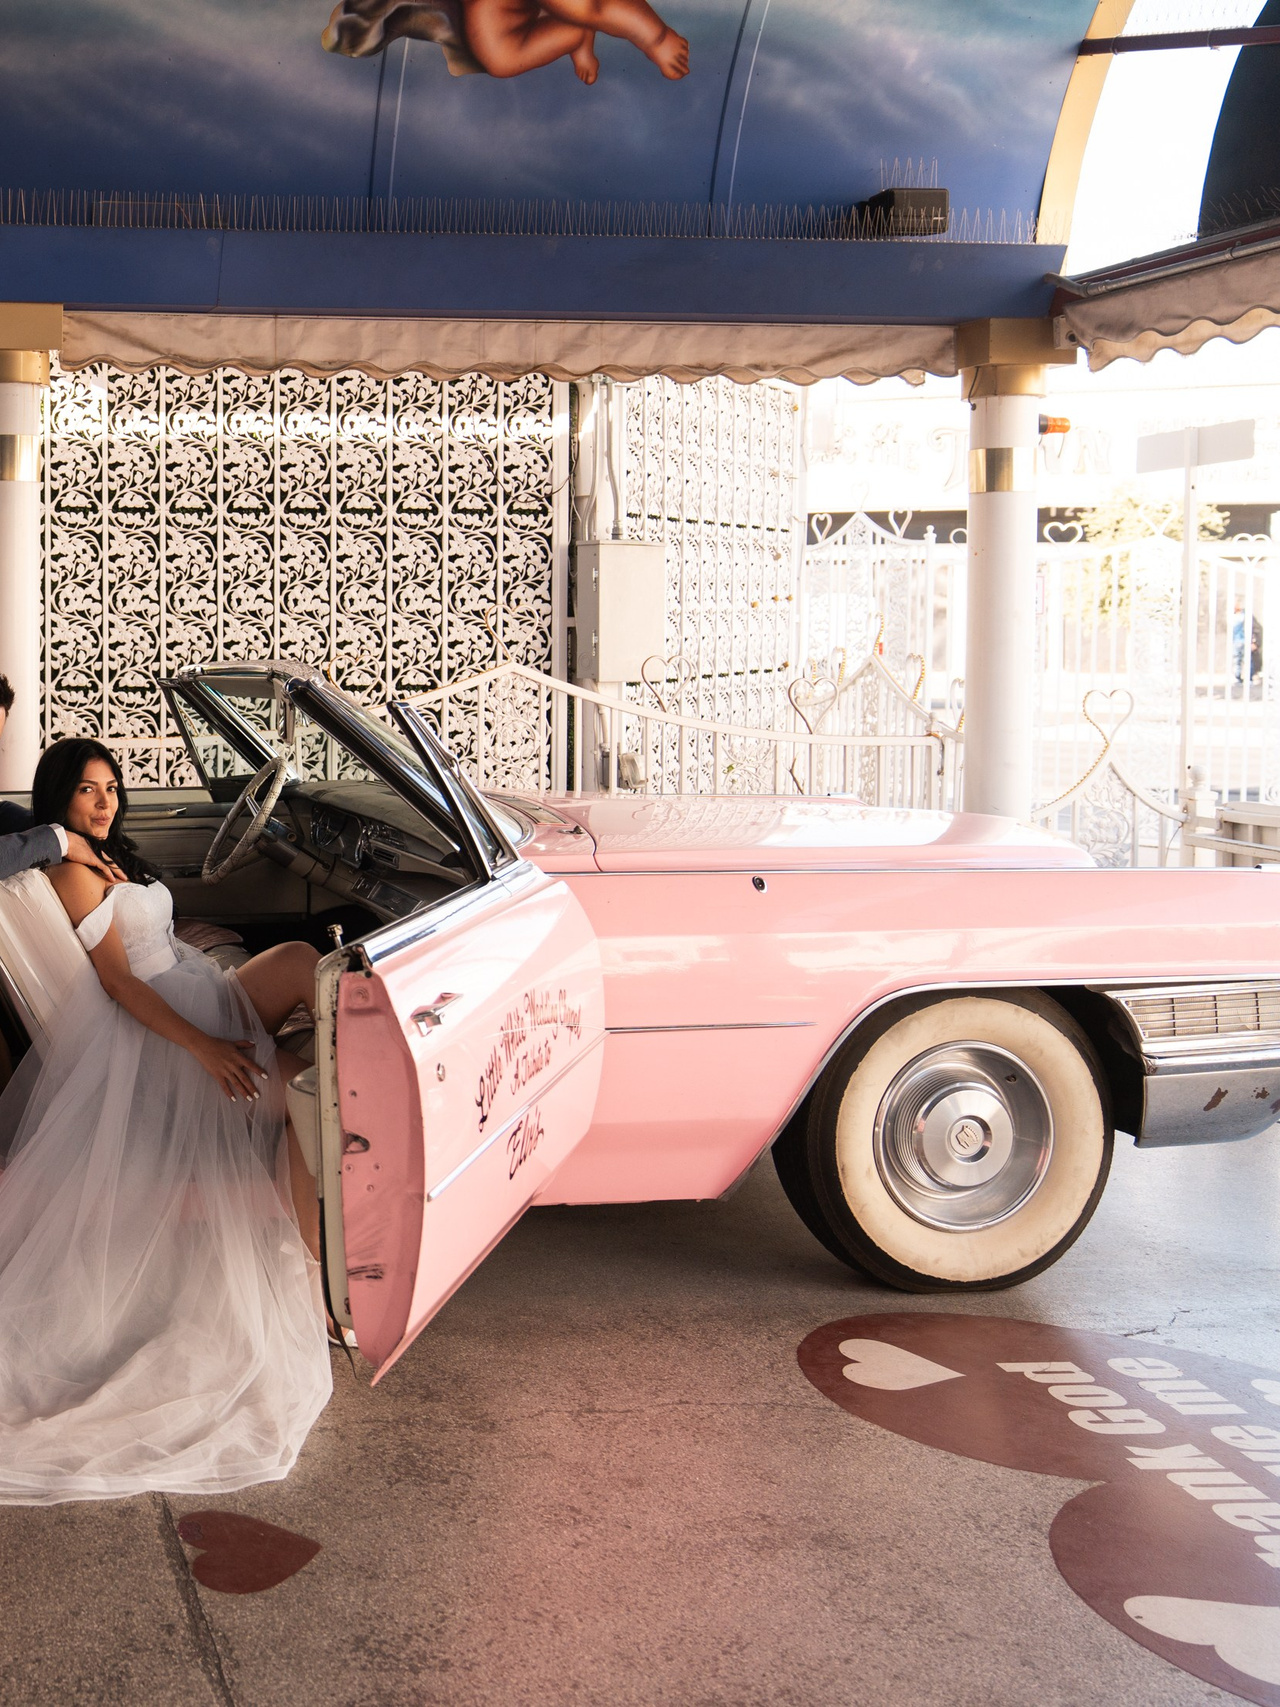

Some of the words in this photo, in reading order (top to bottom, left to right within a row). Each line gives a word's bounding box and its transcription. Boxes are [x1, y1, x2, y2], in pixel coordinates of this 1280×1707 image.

[475, 1044, 503, 1133] Little
[500, 1007, 526, 1067] White
[524, 988, 558, 1040] Wedding
[557, 989, 582, 1047] Chapel
[507, 1105, 544, 1181] Elvis
[995, 1361, 1166, 1434] God
[1107, 1357, 1248, 1415] me
[1124, 1443, 1280, 1568] ank
